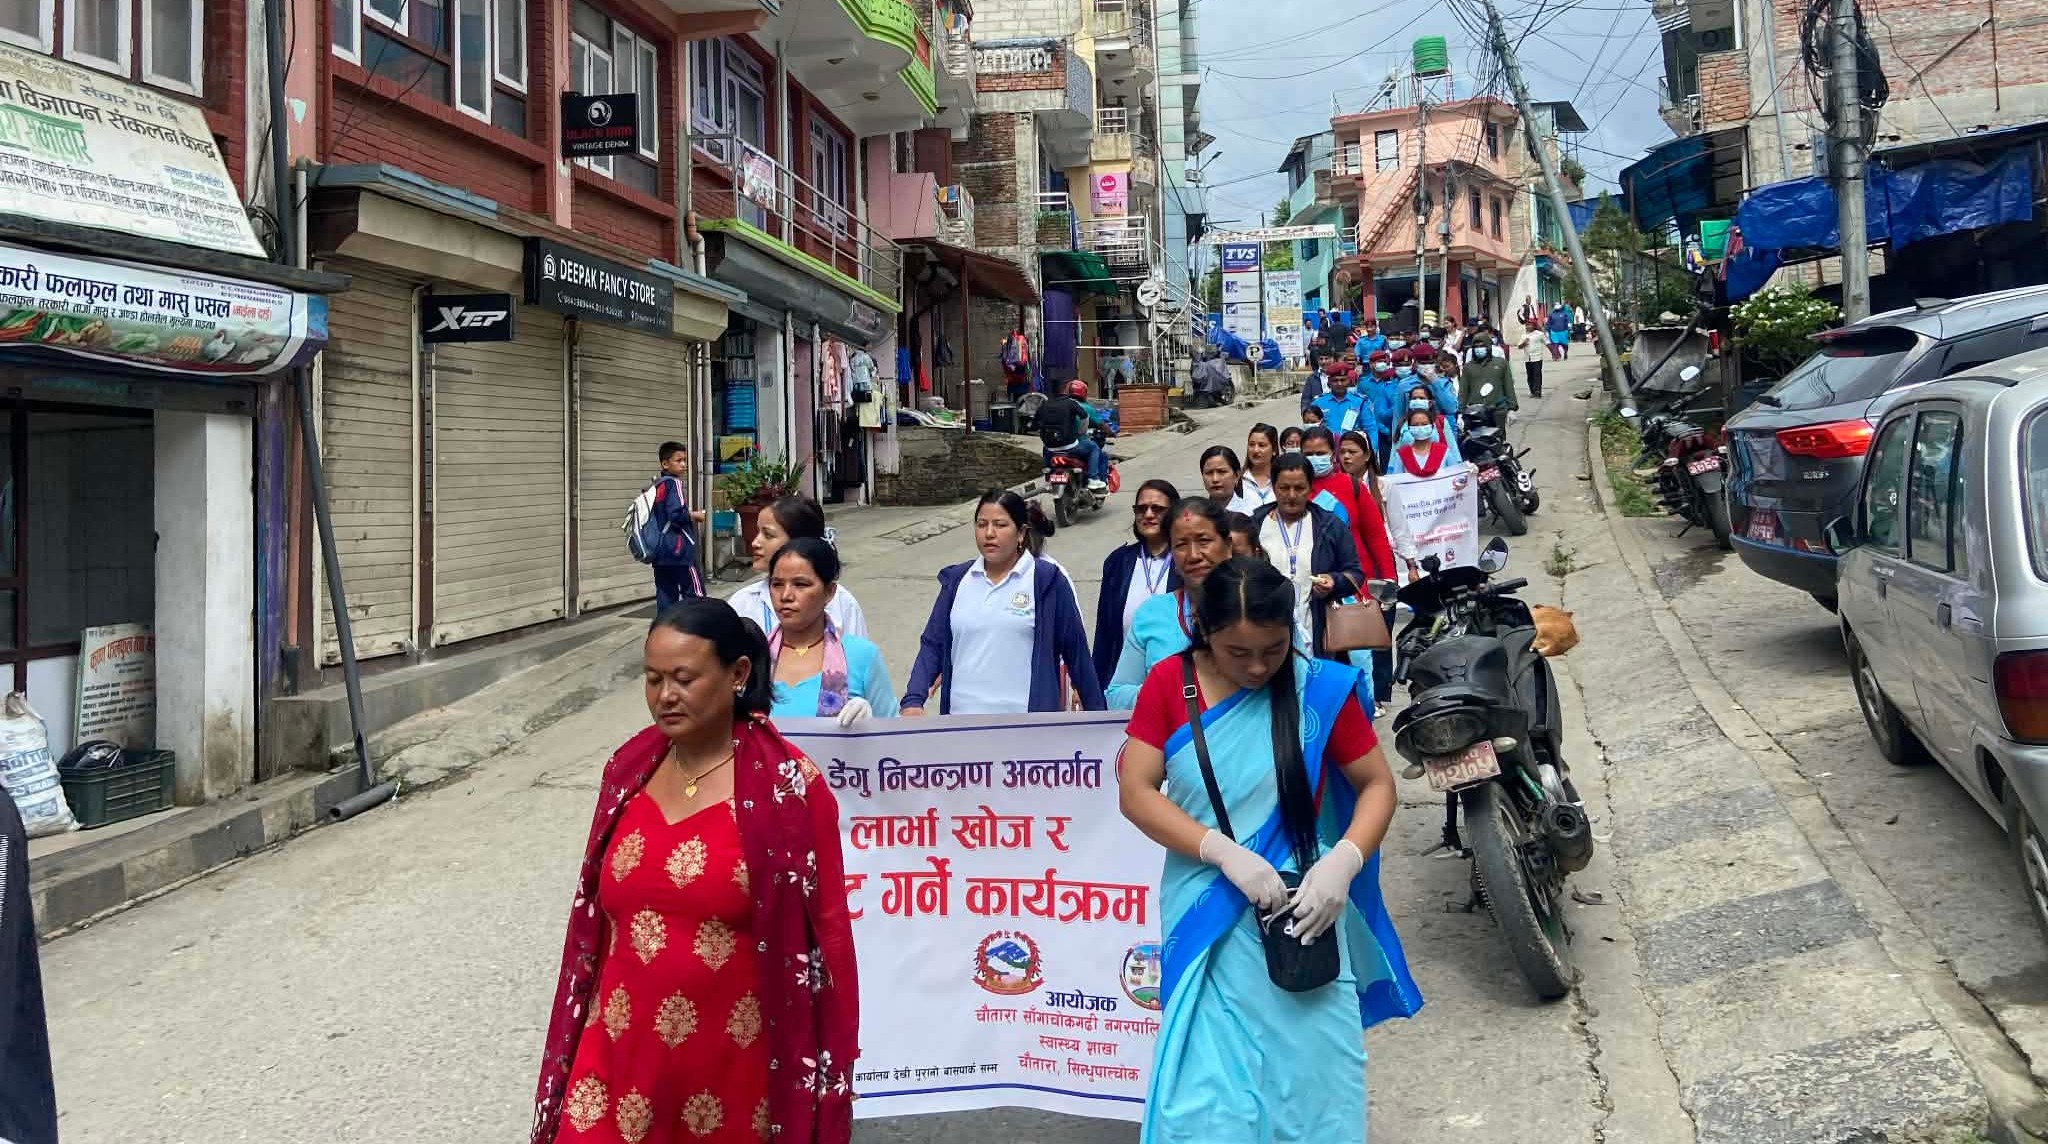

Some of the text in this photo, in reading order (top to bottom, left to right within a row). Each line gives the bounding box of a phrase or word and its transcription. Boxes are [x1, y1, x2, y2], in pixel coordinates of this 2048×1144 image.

[106, 108, 179, 146] संकलन
[572, 140, 629, 150] VINTAGE DENIM
[1225, 248, 1256, 260] TVS
[0, 264, 40, 291] कारी
[45, 272, 117, 305] फलफुल
[123, 284, 154, 307] तथा
[158, 290, 190, 318] मासु
[194, 295, 231, 318] पसल
[560, 258, 597, 290] DEEPAK
[599, 271, 628, 297] FANCY
[629, 280, 656, 306] STORE
[425, 306, 508, 333] XTEP
[877, 757, 993, 792] नियन्त्रण
[1002, 750, 1103, 790] अन्तर्गत
[850, 805, 1073, 853] लार्भा खोज र
[881, 855, 953, 918] गर्ने
[965, 868, 1150, 926] कार्यक्रम
[1046, 989, 1119, 1012] आयोजक
[975, 1004, 1018, 1024] चौतारा
[1104, 1017, 1161, 1038] नगरपालि
[1039, 1035, 1119, 1057] स्वास्थ्य शाखा
[1067, 1057, 1141, 1083] सिन्धुपाल्चोक
